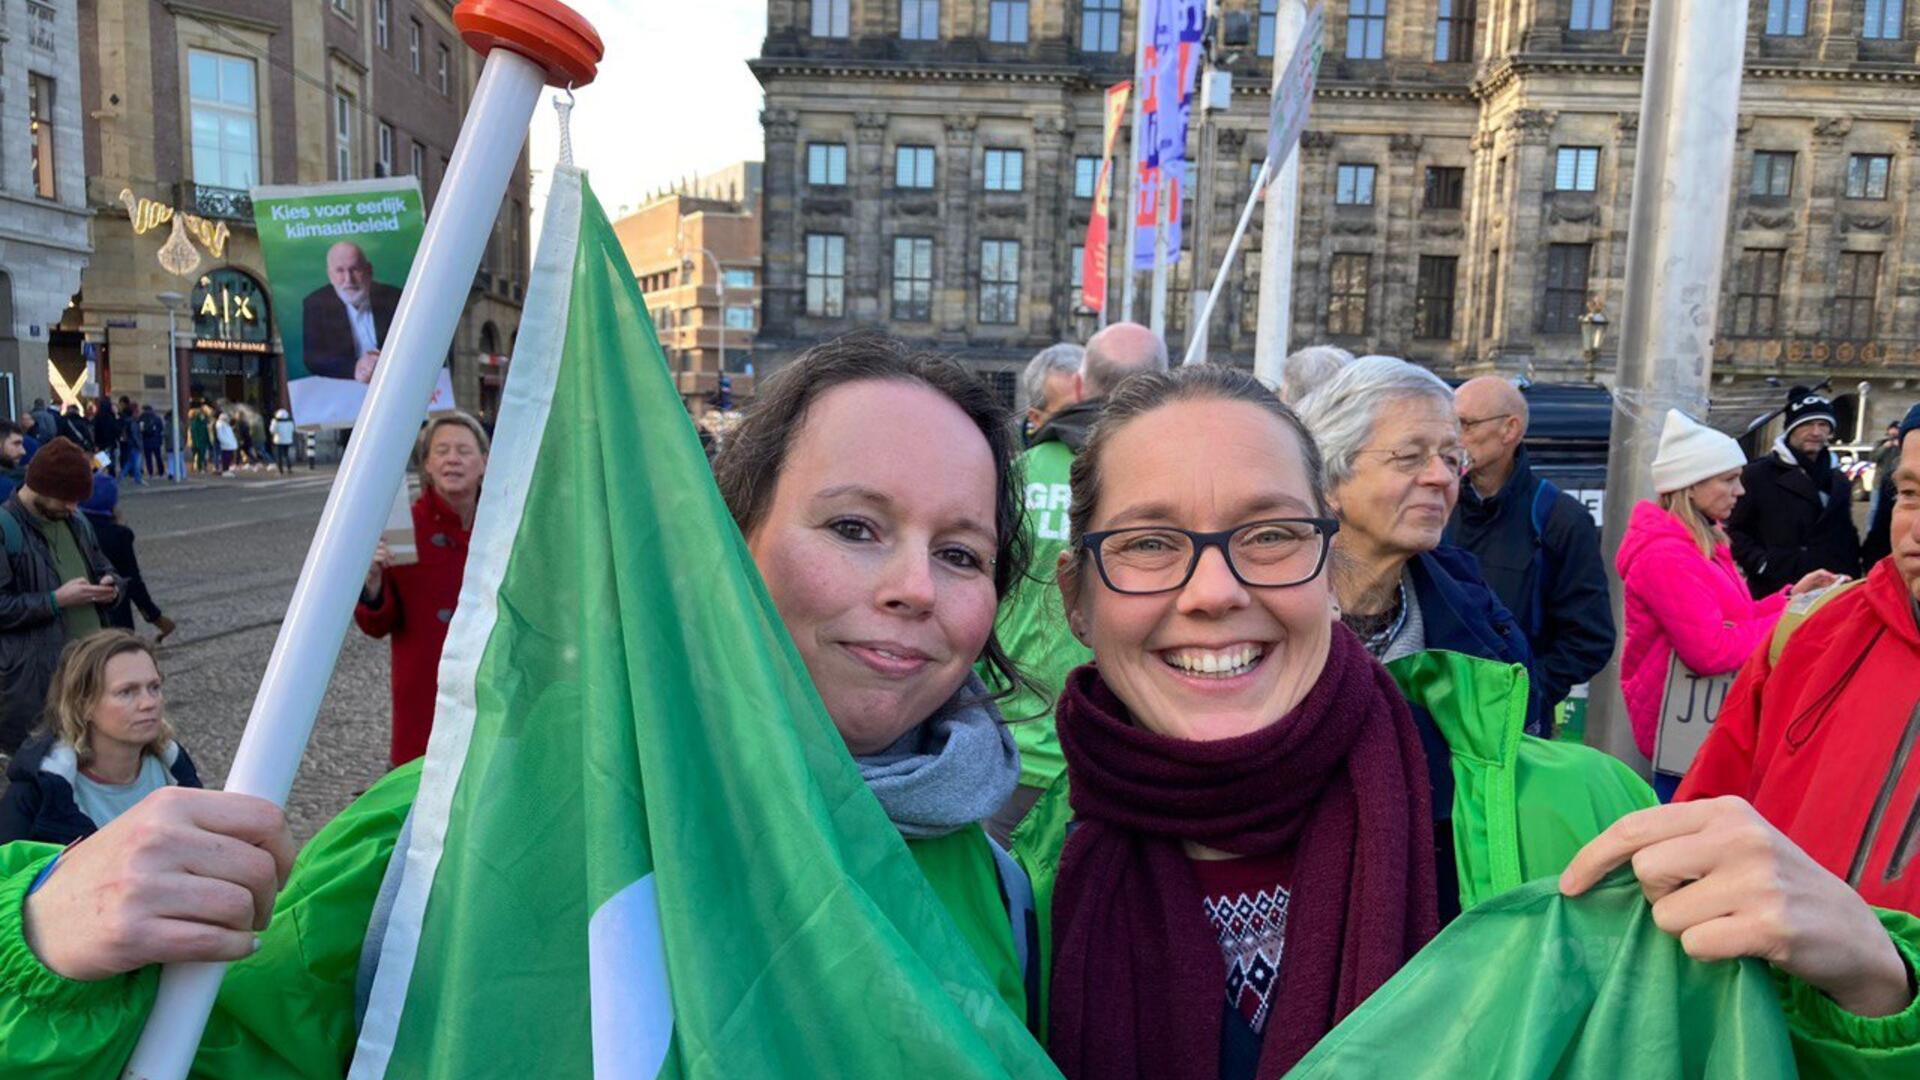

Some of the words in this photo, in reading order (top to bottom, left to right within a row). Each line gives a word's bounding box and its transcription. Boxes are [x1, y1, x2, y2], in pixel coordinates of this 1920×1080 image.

[271, 205, 310, 220] Kies
[314, 204, 352, 218] voor
[356, 198, 406, 215] eerlijk
[285, 216, 399, 238] klimaatbeleid
